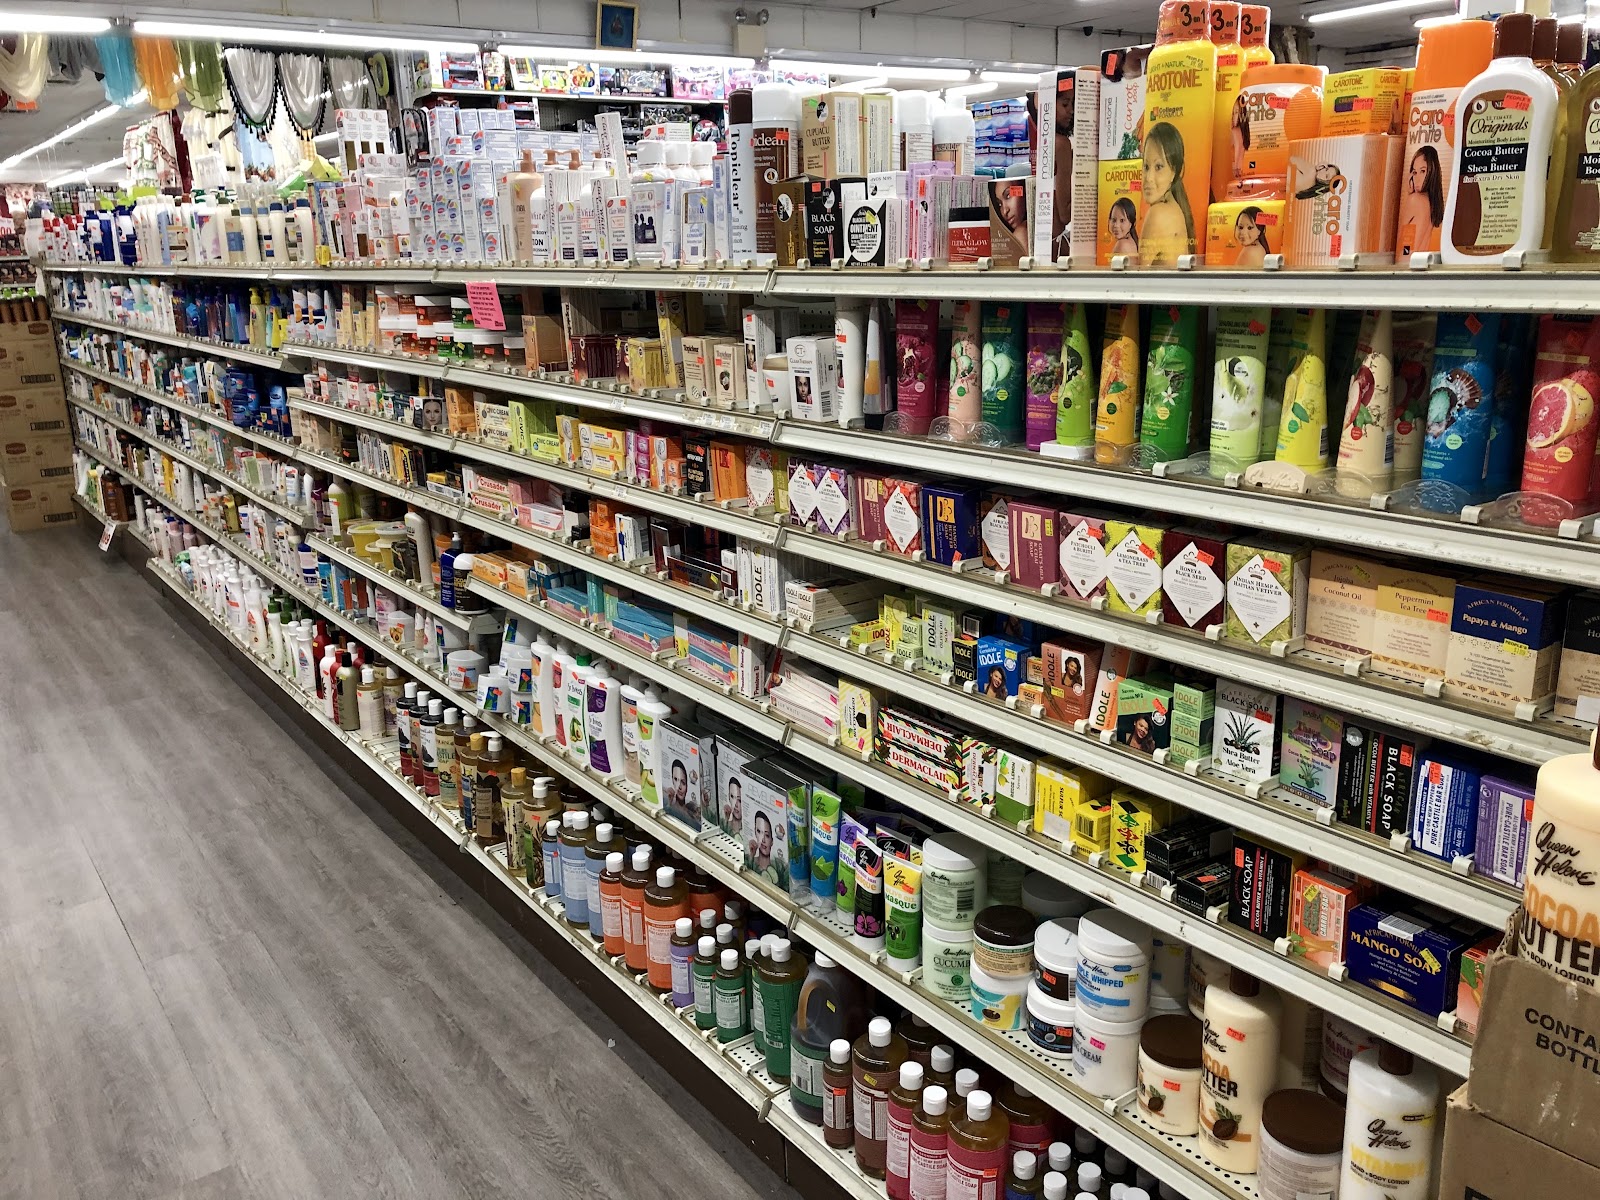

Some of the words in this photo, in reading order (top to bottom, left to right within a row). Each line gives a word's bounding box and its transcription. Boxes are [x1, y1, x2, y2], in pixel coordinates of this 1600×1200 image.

[1470, 118, 1528, 138] Originals
[1464, 148, 1492, 158] Cocoa
[1495, 146, 1524, 155] Butter
[1467, 164, 1488, 172] Shea
[1490, 163, 1518, 172] Butter
[812, 214, 836, 222] BLACK
[814, 225, 834, 234] SOAP
[755, 567, 763, 608] IDOLE
[1236, 576, 1254, 586] INDIAN
[1256, 580, 1274, 588] HEMP
[1324, 587, 1350, 598] Coconut
[1396, 592, 1434, 606] Peppermint
[1413, 606, 1426, 614] Tree
[903, 624, 917, 634] IDOLE
[1463, 614, 1488, 626] Papaya
[1500, 622, 1528, 635] Mango
[955, 648, 970, 658] IDOLE
[979, 652, 1003, 665] IDOLE
[955, 670, 972, 680] IDOLE
[1096, 690, 1110, 726] IDOLE
[1222, 694, 1244, 706] BLACK
[1248, 702, 1269, 712] SOAP
[1226, 759, 1240, 768] Aloe
[1240, 751, 1260, 764] Butter
[1386, 748, 1398, 790] BLACK
[1382, 794, 1394, 830] SOAP
[1536, 822, 1580, 857] Queen
[1244, 856, 1254, 886] SOAP
[1241, 886, 1252, 918] BLACK
[1351, 931, 1400, 958] MANGO
[1530, 953, 1553, 970] BODY
[1555, 966, 1594, 987] LOTION
[1092, 975, 1124, 988] WHIPPED
[1368, 1119, 1402, 1135] Queen
